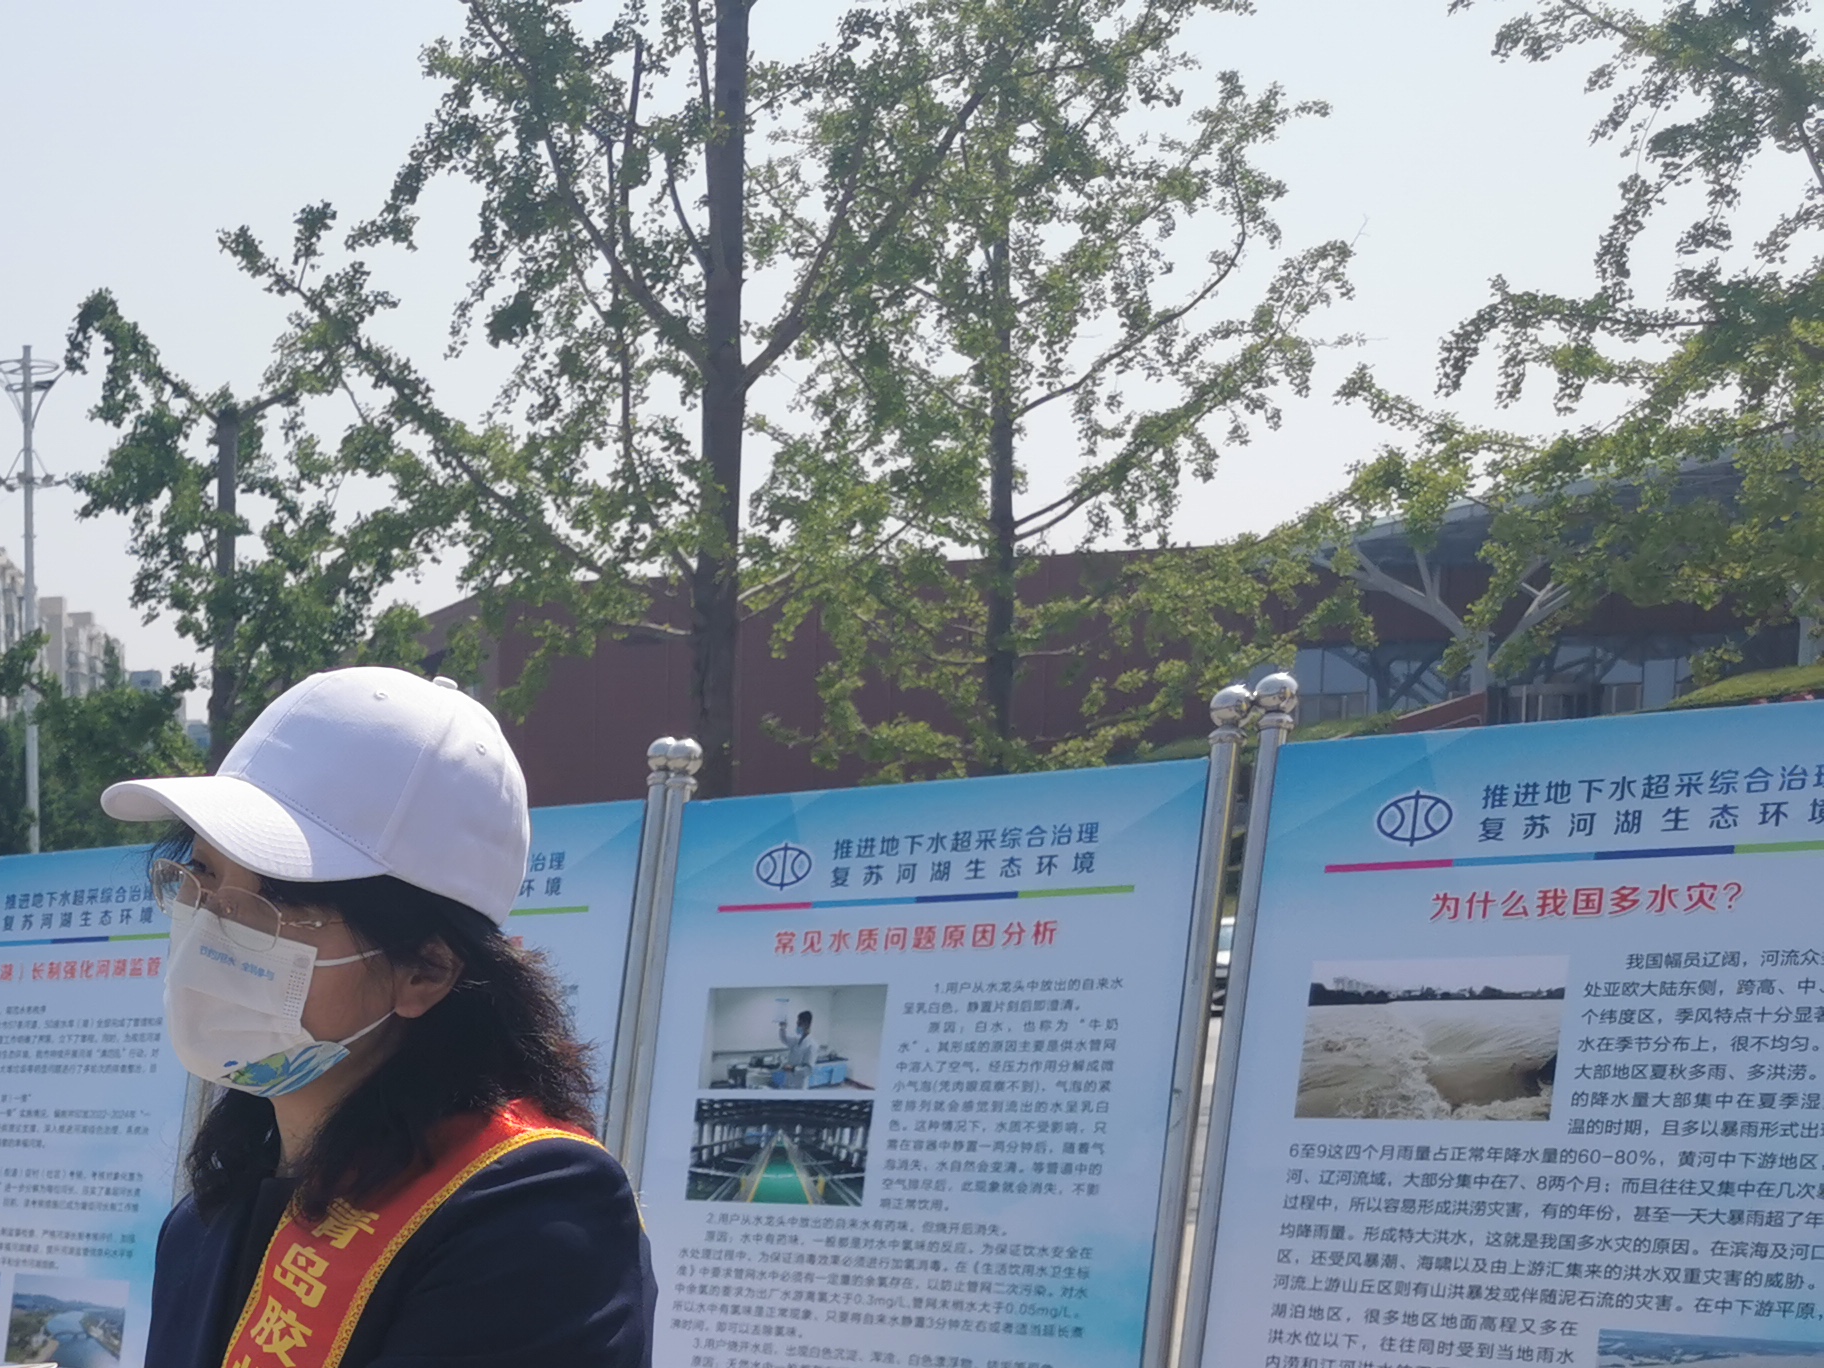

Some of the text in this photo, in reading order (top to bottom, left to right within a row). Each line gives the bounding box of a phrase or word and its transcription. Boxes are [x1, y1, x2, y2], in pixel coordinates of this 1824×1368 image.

[832, 821, 1100, 861] 推进地下水超采综合治理
[529, 850, 566, 872] 治理
[829, 851, 1096, 888] 复苏河湖生态环境
[1429, 882, 1743, 921] 为什么我国多水灾？
[774, 919, 1059, 955] 常见水质问题原因分析
[1626, 948, 1824, 970] 我国幅员辽阔，河流众
[1577, 1034, 1820, 1053] 水在季节分布上，很不均匀。
[1574, 1062, 1817, 1081] 大部地区夏秋多雨、多洪涝。
[1567, 1117, 1824, 1138] 温的时期，且多以暴雨形式出
